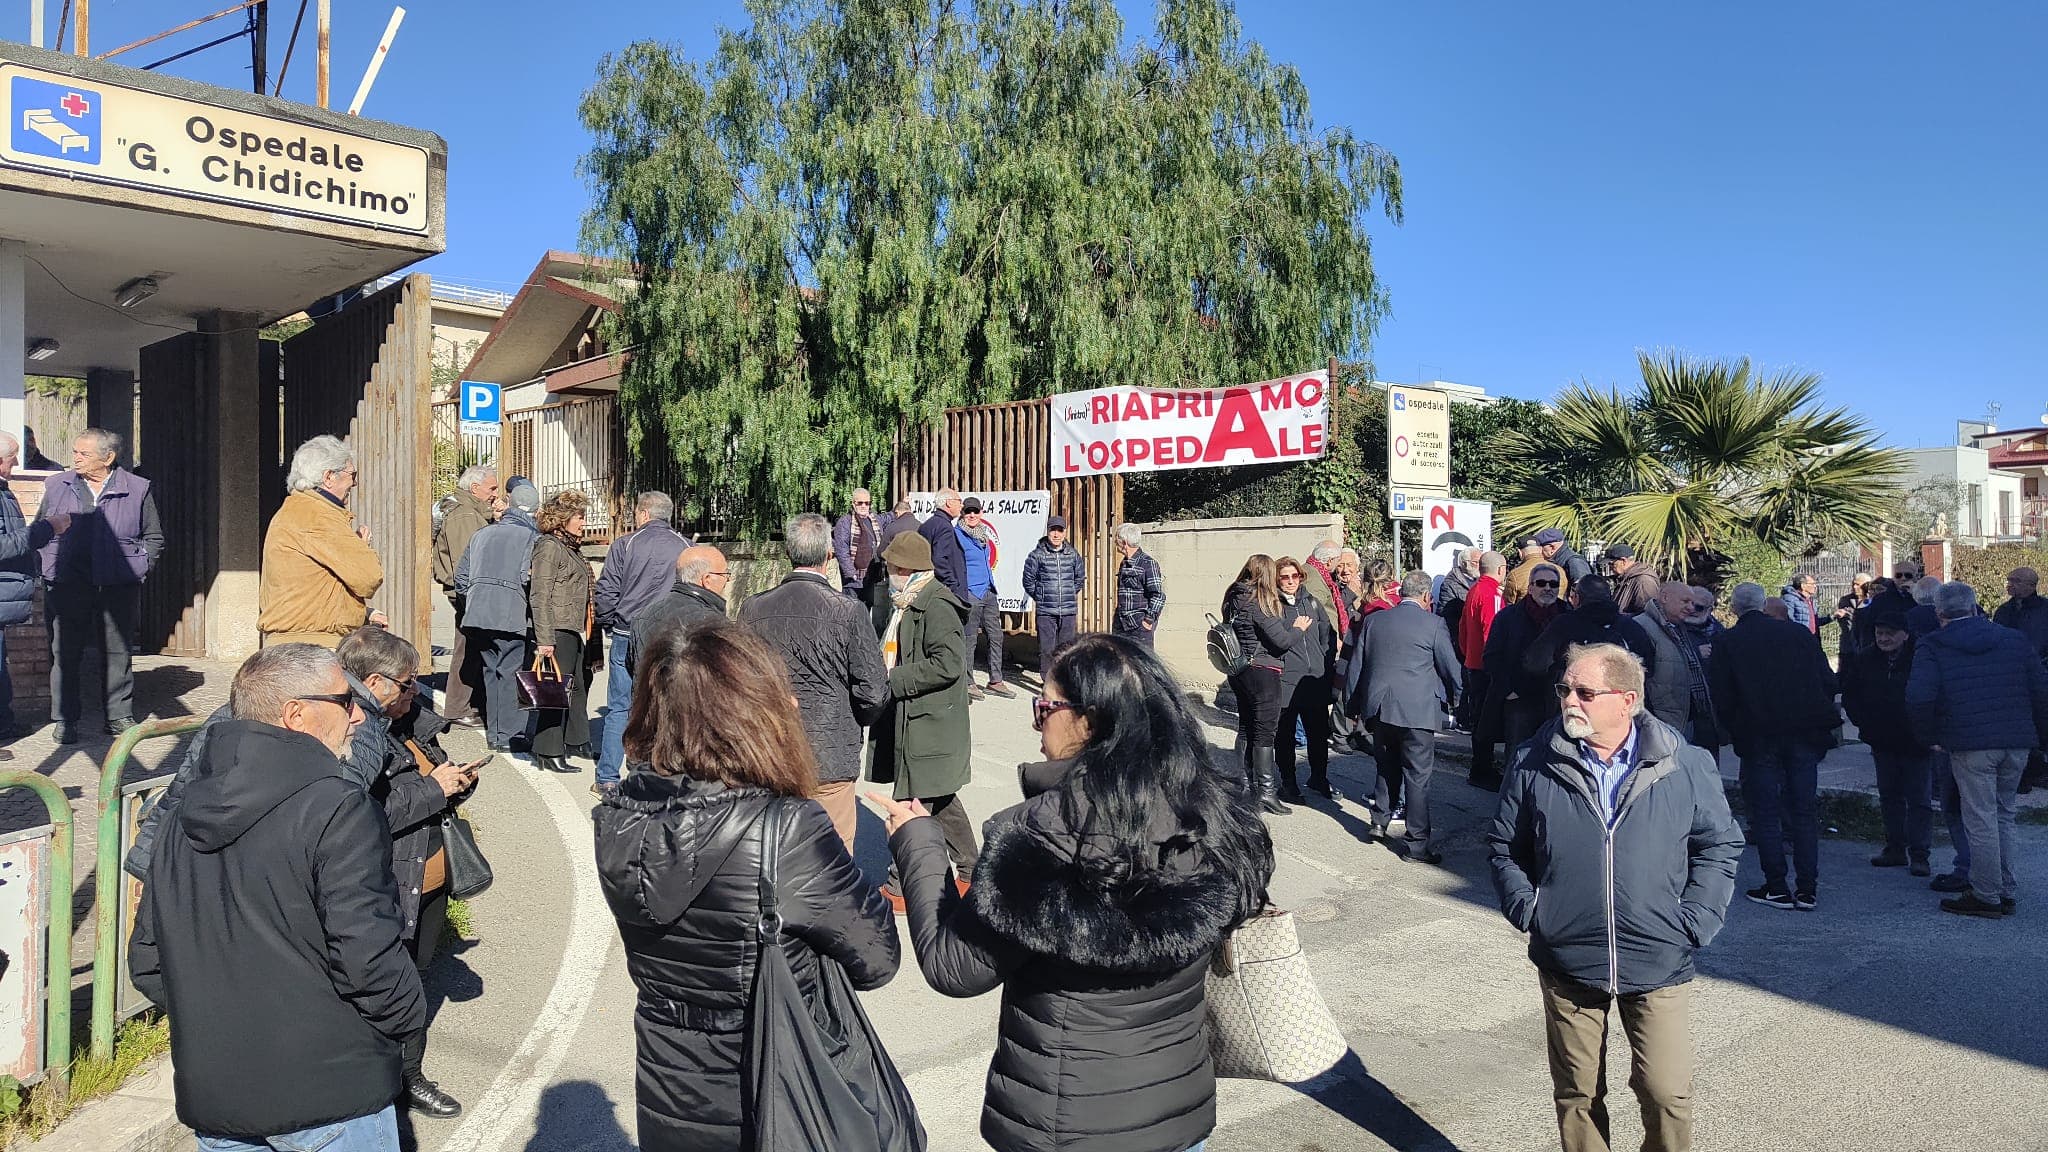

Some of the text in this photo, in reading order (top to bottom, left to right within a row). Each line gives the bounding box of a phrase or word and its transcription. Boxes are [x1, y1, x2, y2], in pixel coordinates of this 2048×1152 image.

[185, 115, 365, 174] Ospedale
[201, 155, 417, 215] Chidichimo"
[468, 385, 493, 418] P
